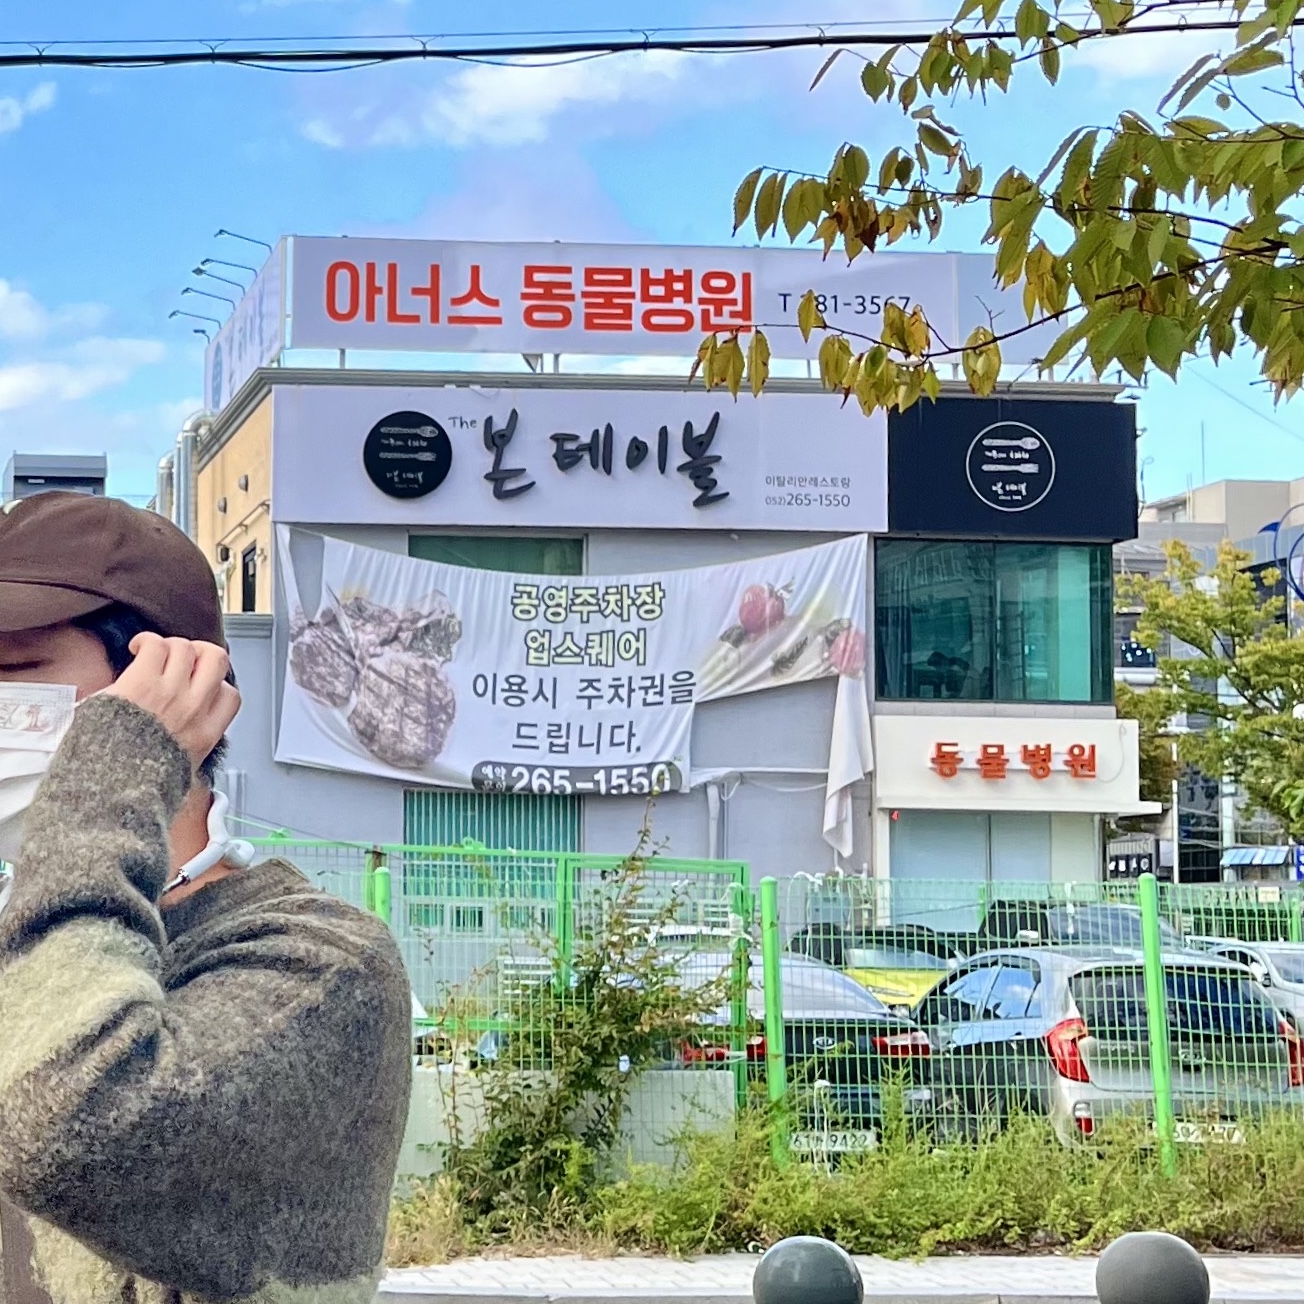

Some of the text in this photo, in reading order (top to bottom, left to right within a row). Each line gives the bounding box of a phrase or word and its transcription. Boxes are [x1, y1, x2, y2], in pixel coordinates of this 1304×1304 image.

[325, 260, 912, 334] 아너스 동물병원 T 81-357
[447, 415, 478, 430] The
[510, 581, 666, 623] 공영주차장
[524, 628, 647, 668] 업스퀘어
[472, 669, 698, 710] 이용시 주차권을
[511, 720, 642, 755] 드립니다.
[511, 763, 671, 796] 265-1550
[931, 742, 1096, 780] 동물병원
